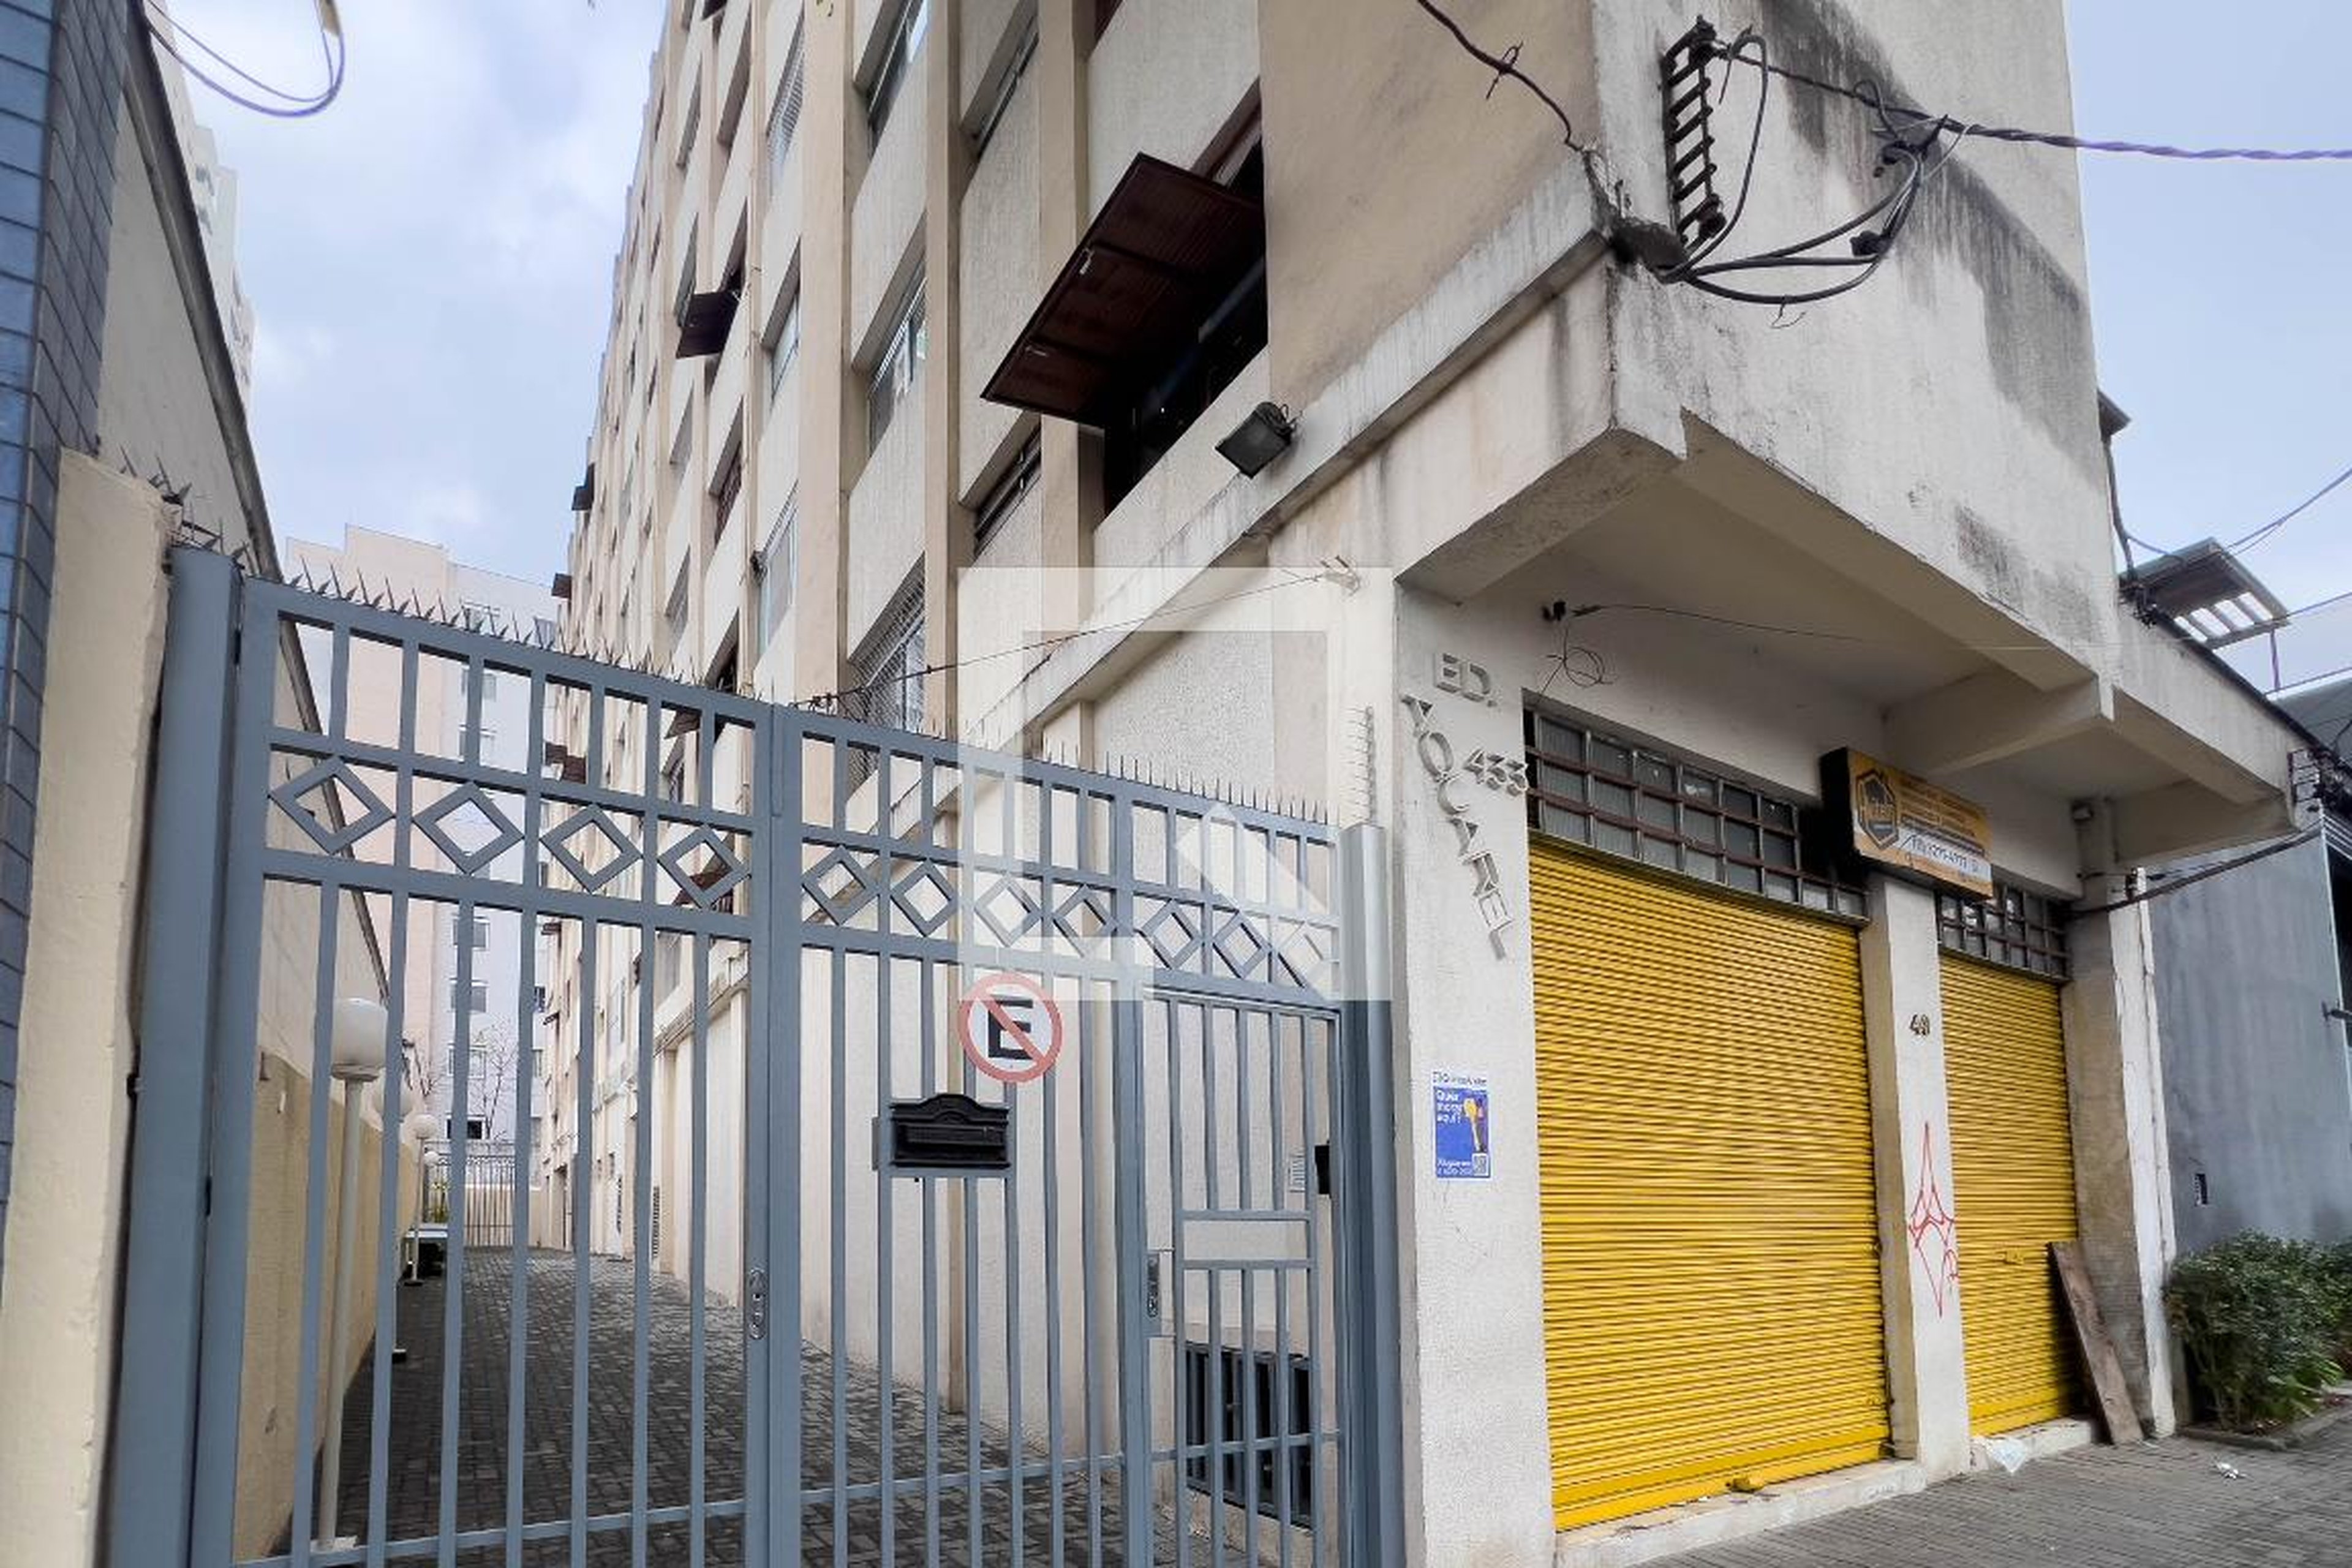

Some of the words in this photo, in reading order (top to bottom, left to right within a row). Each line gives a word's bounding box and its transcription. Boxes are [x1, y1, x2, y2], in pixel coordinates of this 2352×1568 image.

[1433, 652, 1496, 707] ED.
[1463, 747, 1529, 797] 433
[1401, 695, 1513, 960] AQUAREL
[988, 993, 1033, 1060] E
